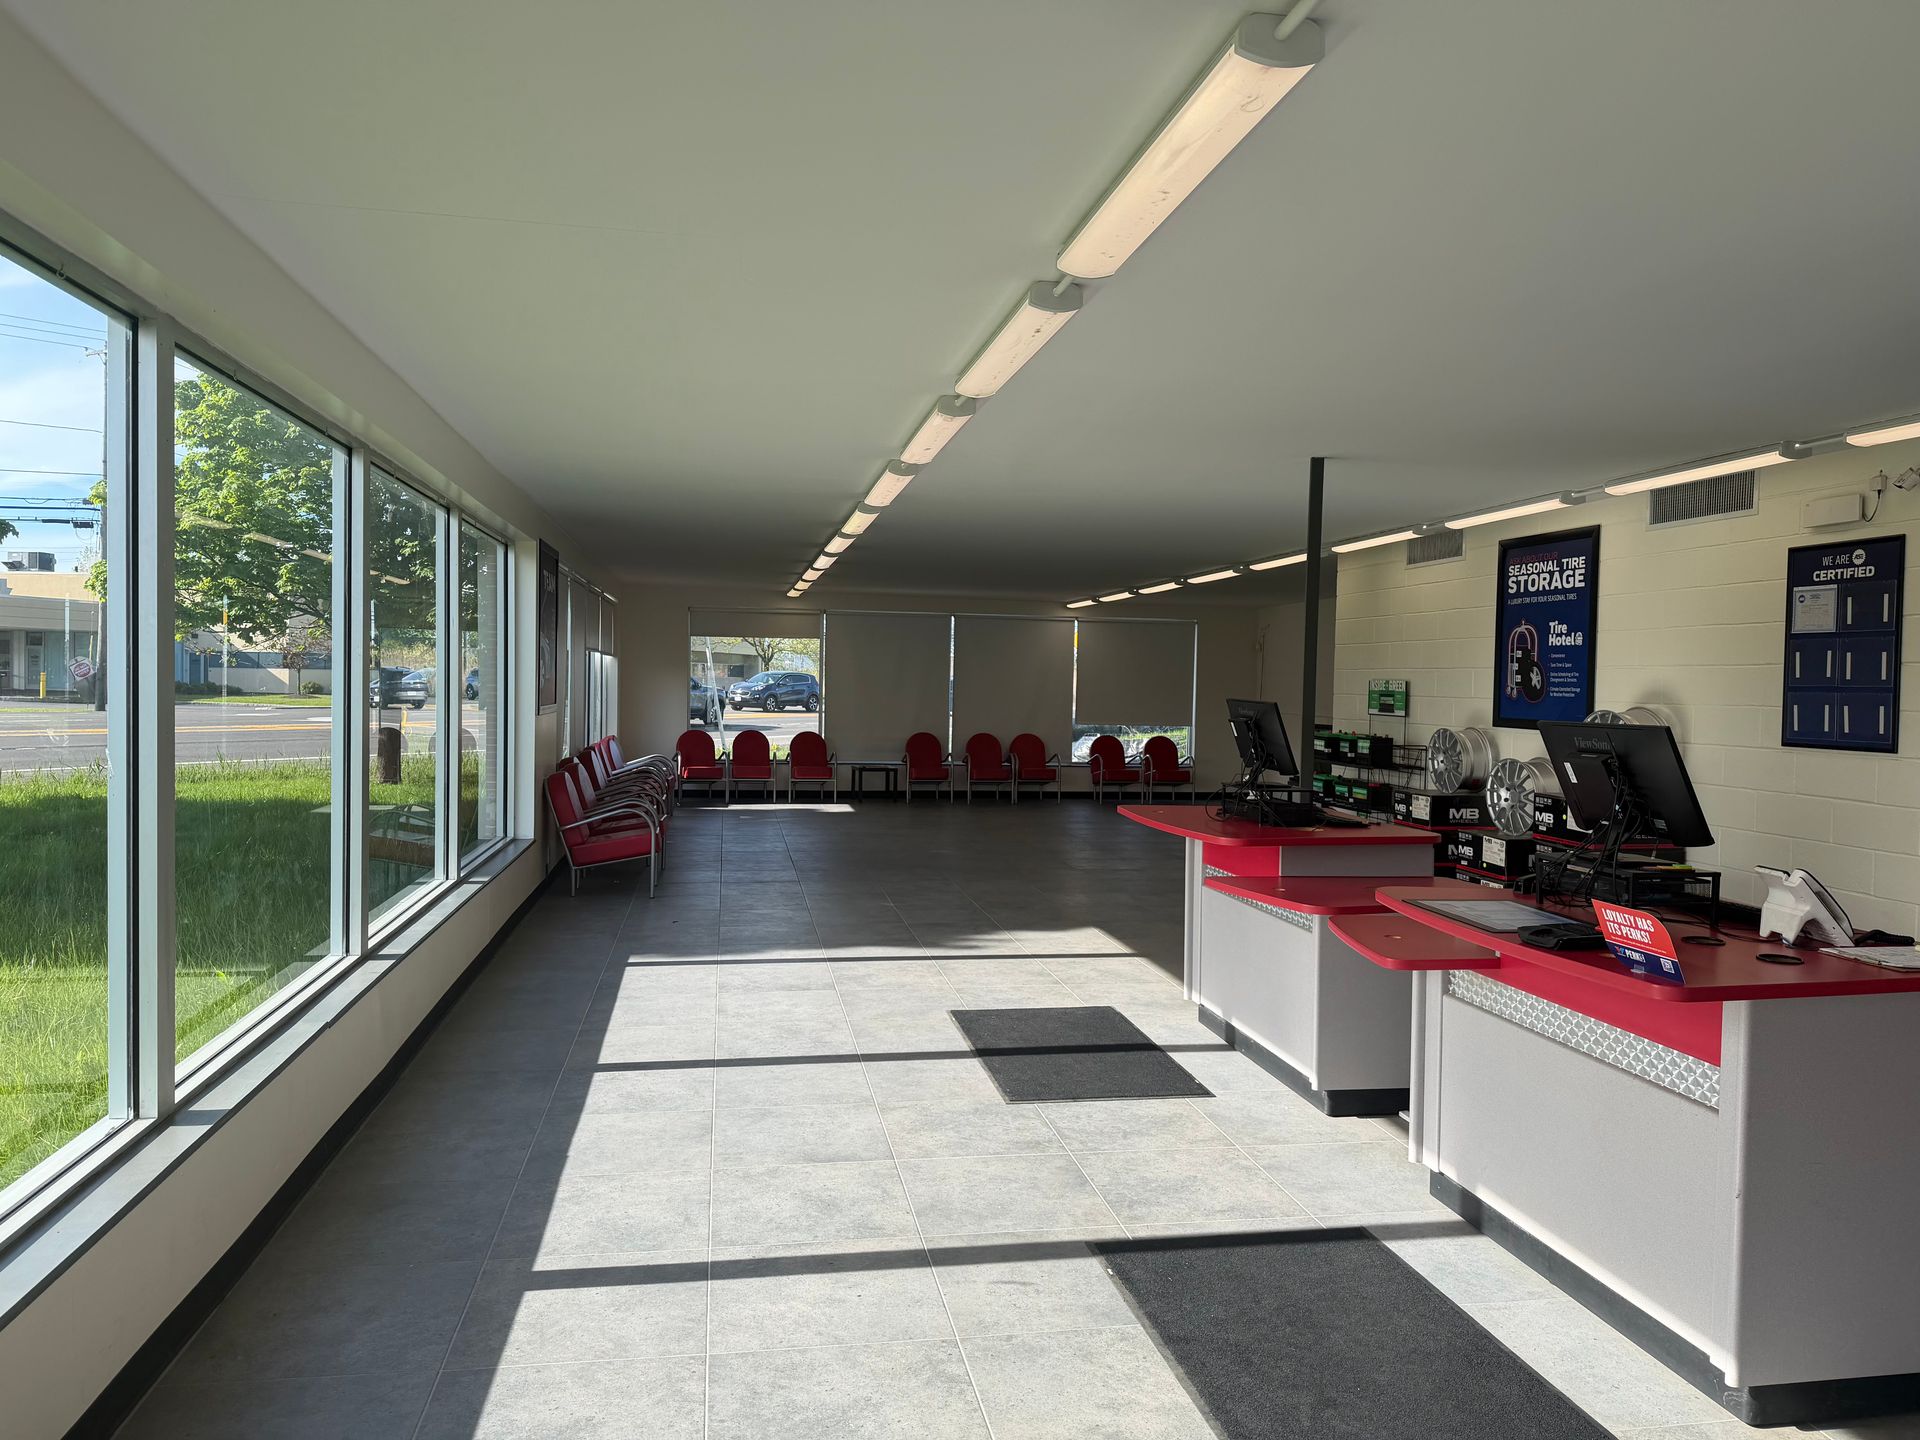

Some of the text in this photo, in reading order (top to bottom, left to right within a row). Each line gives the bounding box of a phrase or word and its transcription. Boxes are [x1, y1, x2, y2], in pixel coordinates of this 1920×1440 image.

[1522, 554, 1543, 563] ABOUT
[1544, 551, 1559, 560] OUR
[1822, 556, 1834, 566] WE
[1835, 554, 1850, 565] ARE
[1509, 556, 1586, 576] SEASONAL TIRE
[1813, 566, 1875, 582] CERTIFIED
[1508, 569, 1585, 594] STORAGE
[1538, 595, 1547, 603] YOUR
[1547, 594, 1566, 602] SEASONAL
[1549, 620, 1568, 634] Tire
[1548, 632, 1575, 646] Hotel
[1388, 680, 1406, 692] GREEN
[1395, 803, 1406, 812] MB
[1449, 808, 1480, 820] MB
[1535, 811, 1554, 824] MB
[1459, 845, 1474, 857] MB
[1602, 908, 1654, 932] LOYALTY HAS
[1607, 921, 1652, 944] ITS PERKS!
